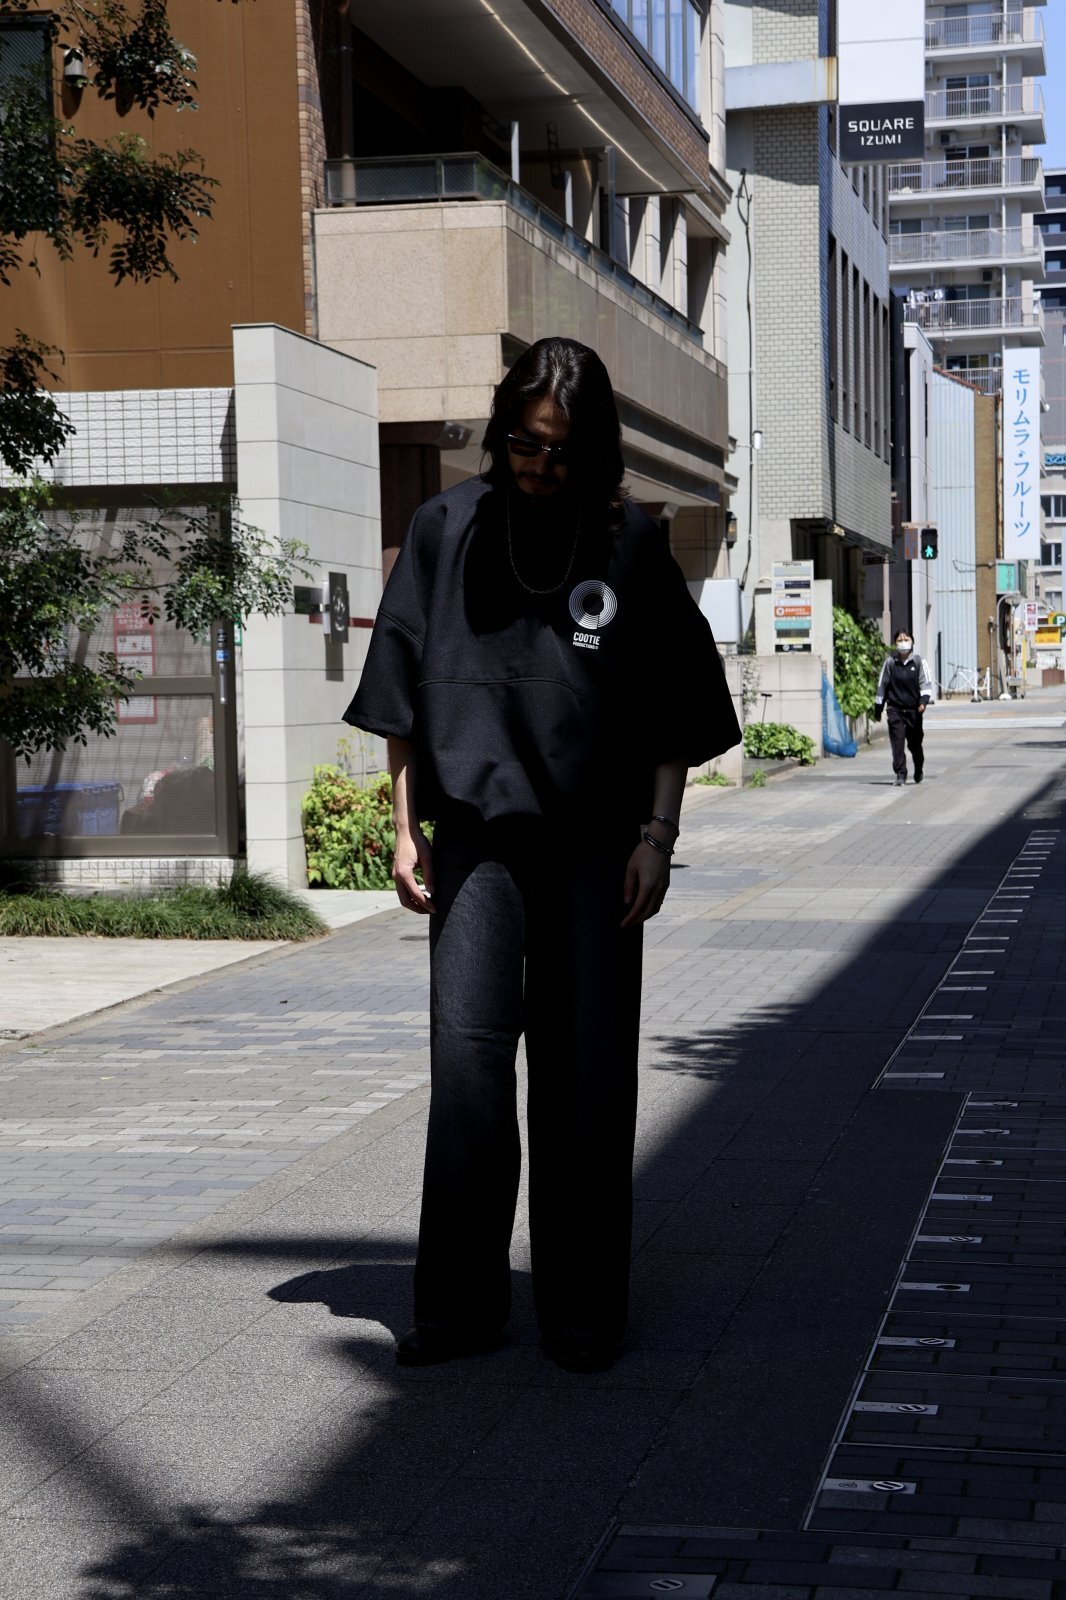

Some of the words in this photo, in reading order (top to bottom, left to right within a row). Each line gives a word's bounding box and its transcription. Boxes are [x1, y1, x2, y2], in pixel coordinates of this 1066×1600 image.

[848, 117, 914, 132] SQUARE
[861, 134, 902, 146] IZUMI
[1012, 368, 1032, 538] モリムラ・フルーツ
[1056, 616, 1066, 626] P
[573, 632, 600, 645] COOTIE
